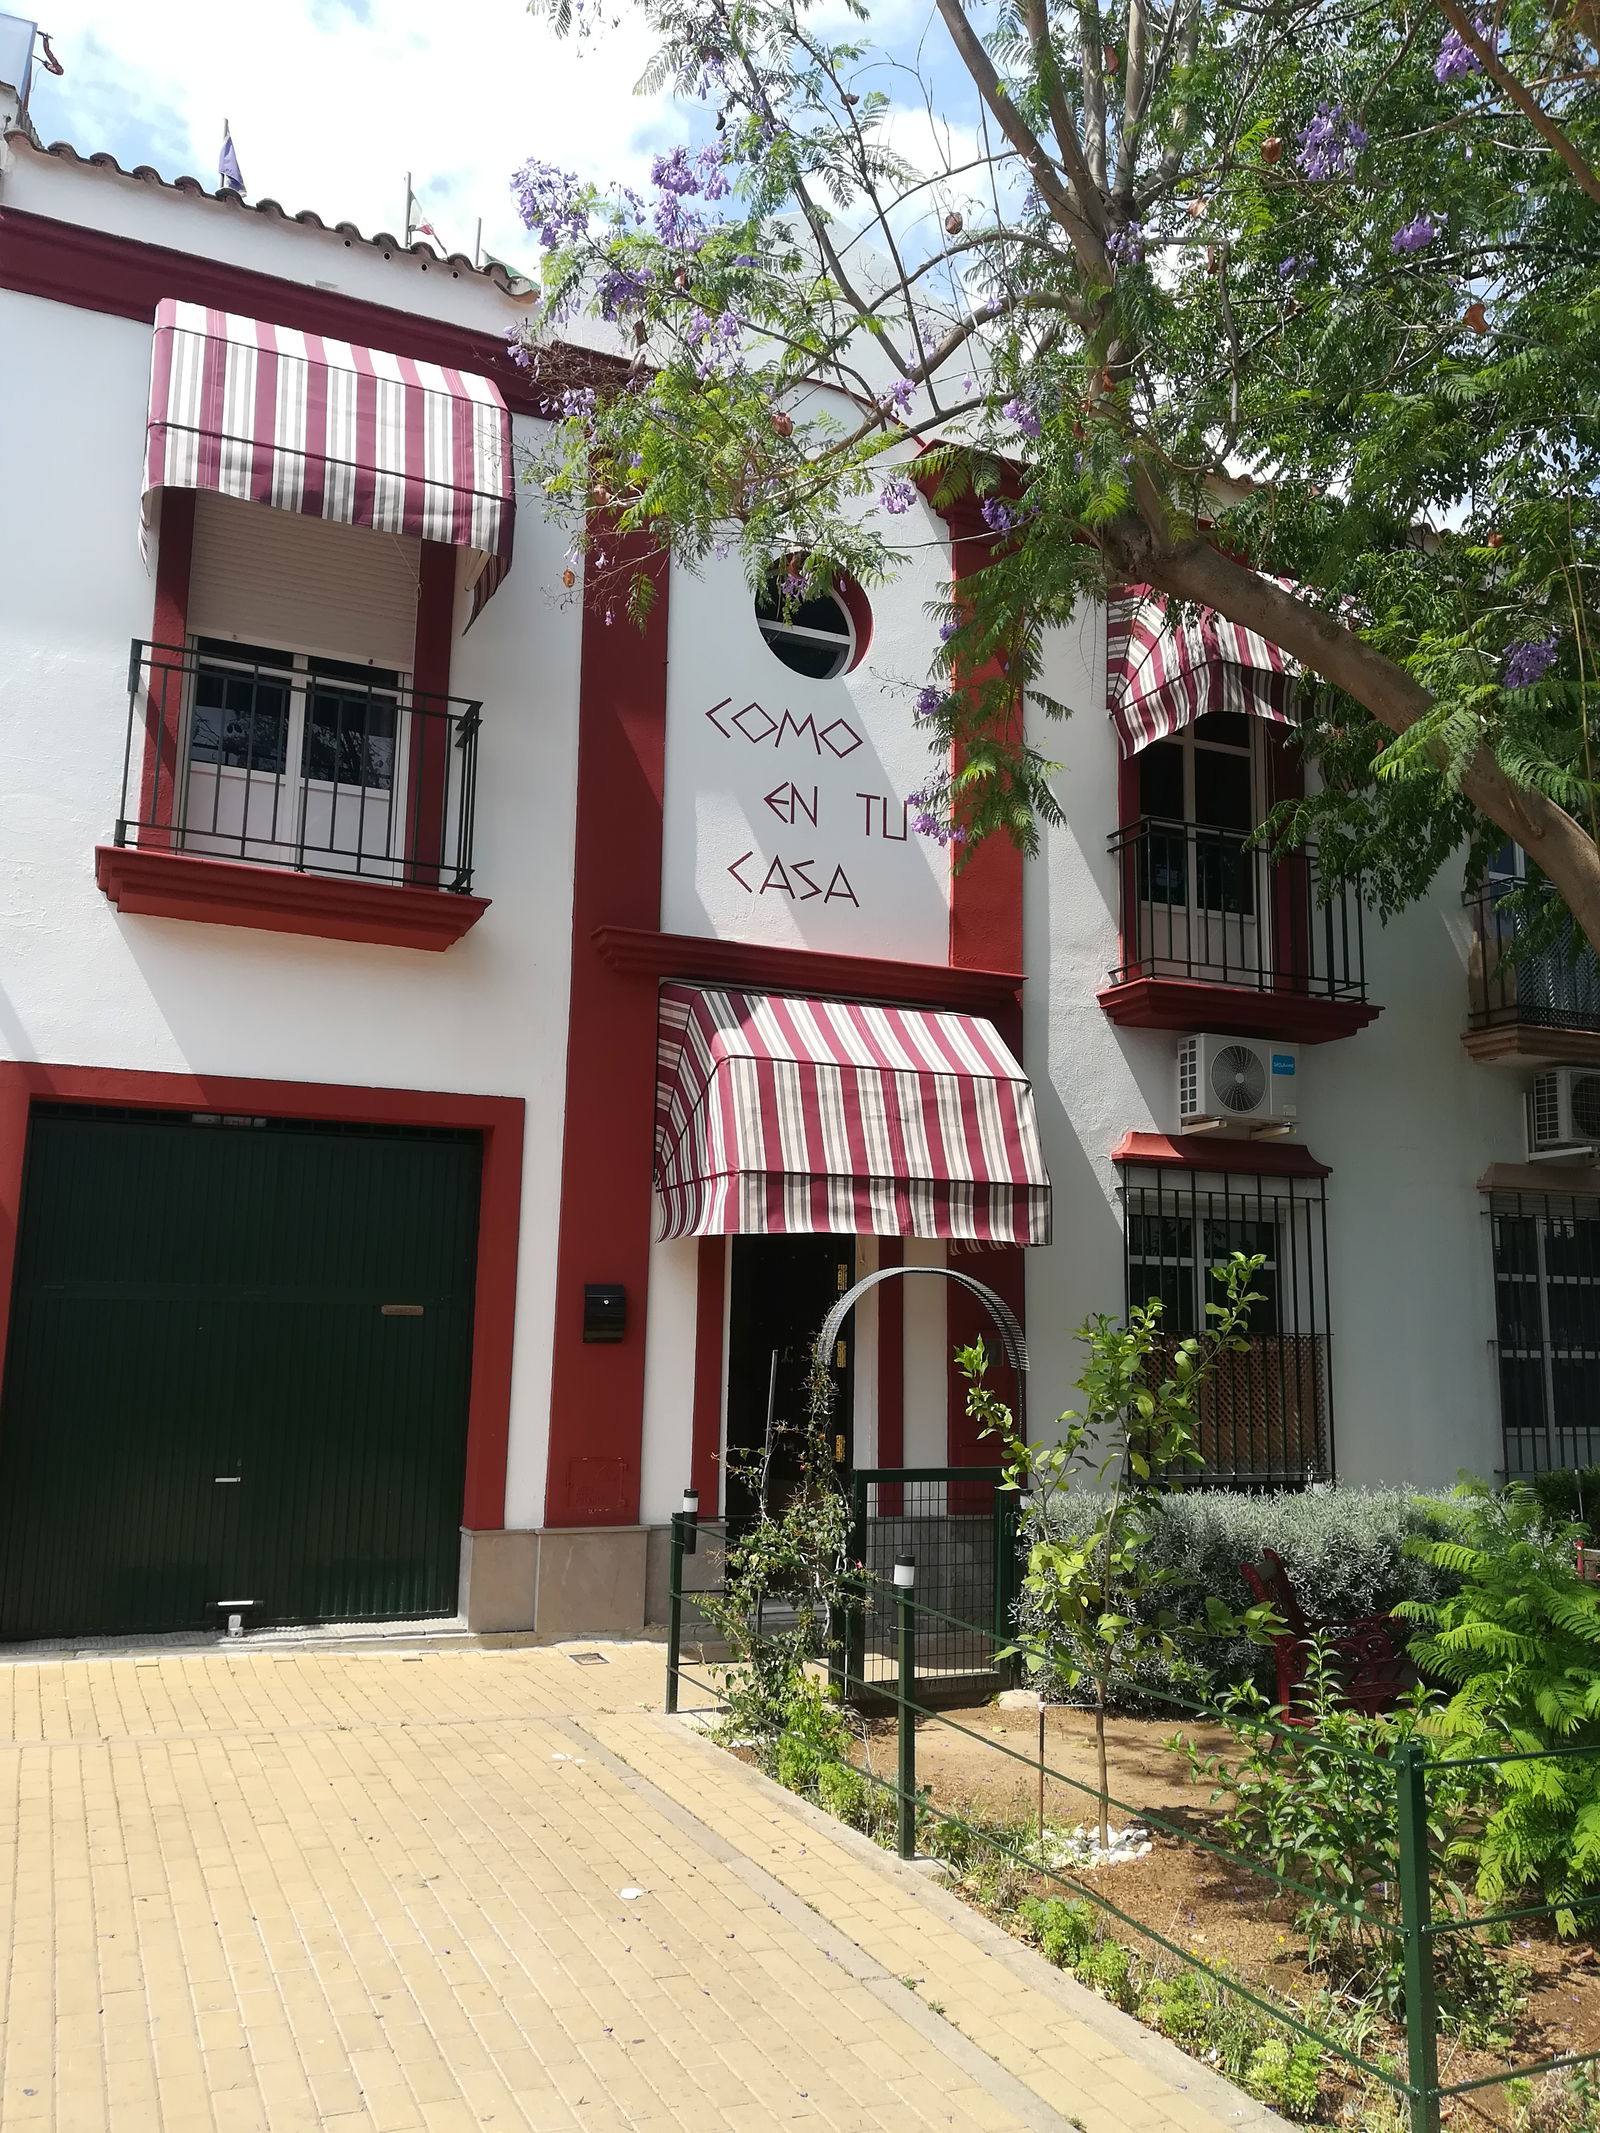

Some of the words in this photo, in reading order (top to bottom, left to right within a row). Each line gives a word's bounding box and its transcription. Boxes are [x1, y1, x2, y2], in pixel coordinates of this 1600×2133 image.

[705, 697, 863, 758] COMO
[763, 781, 818, 828] EN
[856, 792, 907, 841] TU
[727, 850, 860, 907] CASA
